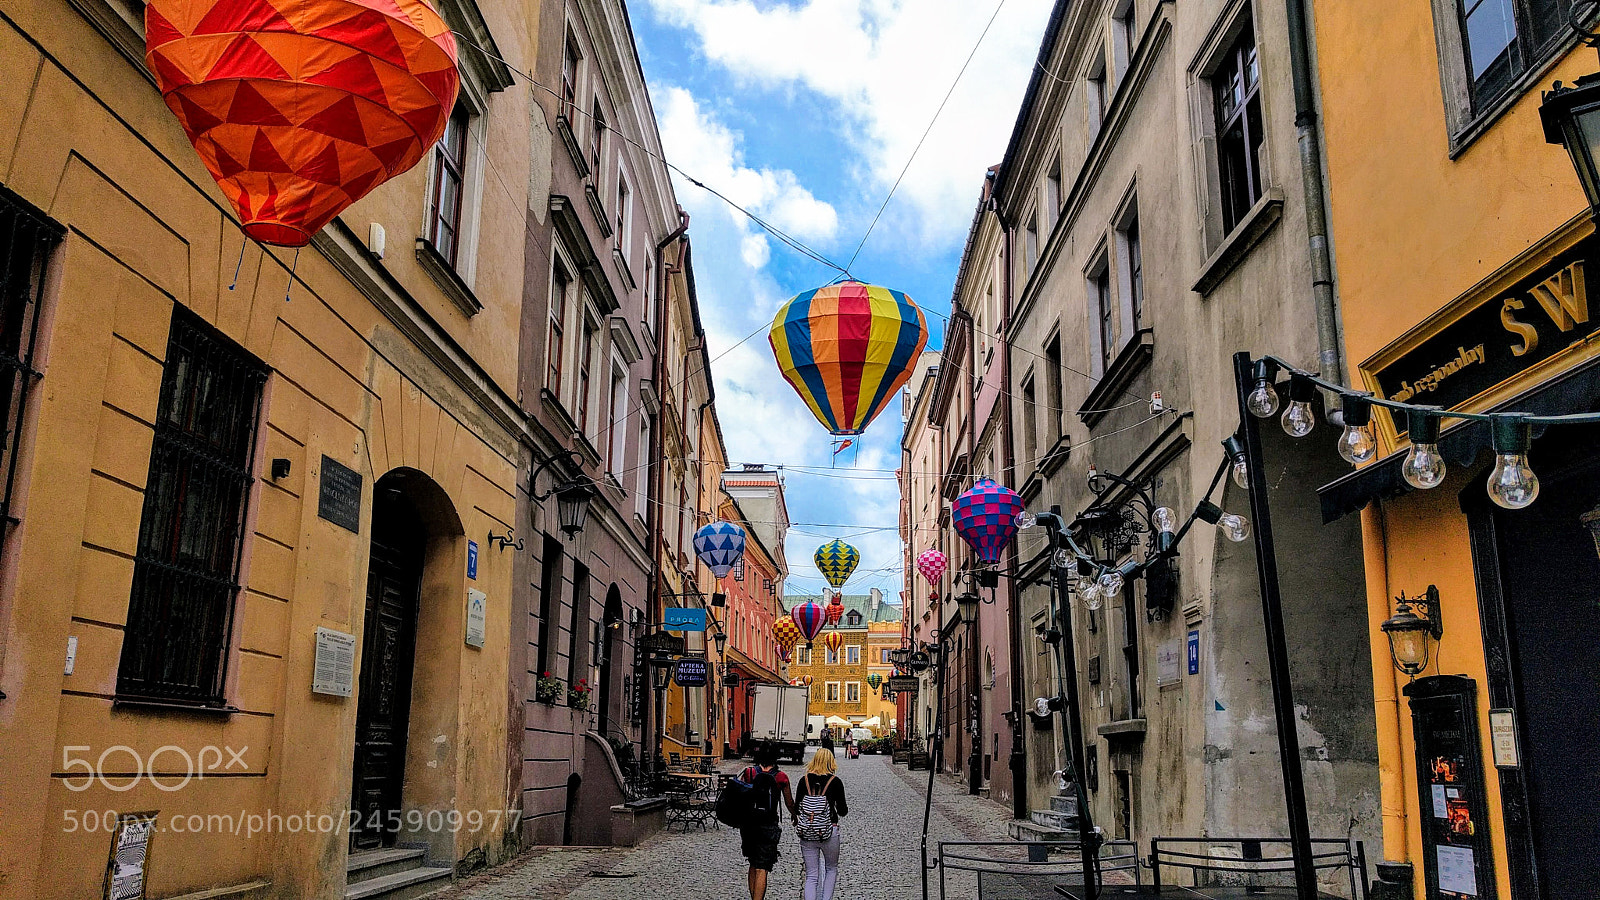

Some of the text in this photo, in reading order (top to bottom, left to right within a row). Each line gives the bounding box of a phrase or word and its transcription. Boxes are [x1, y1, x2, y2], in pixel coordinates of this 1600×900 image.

[1414, 343, 1485, 392] regionalny
[470, 553, 476, 569] 7
[1189, 644, 1197, 662] 14
